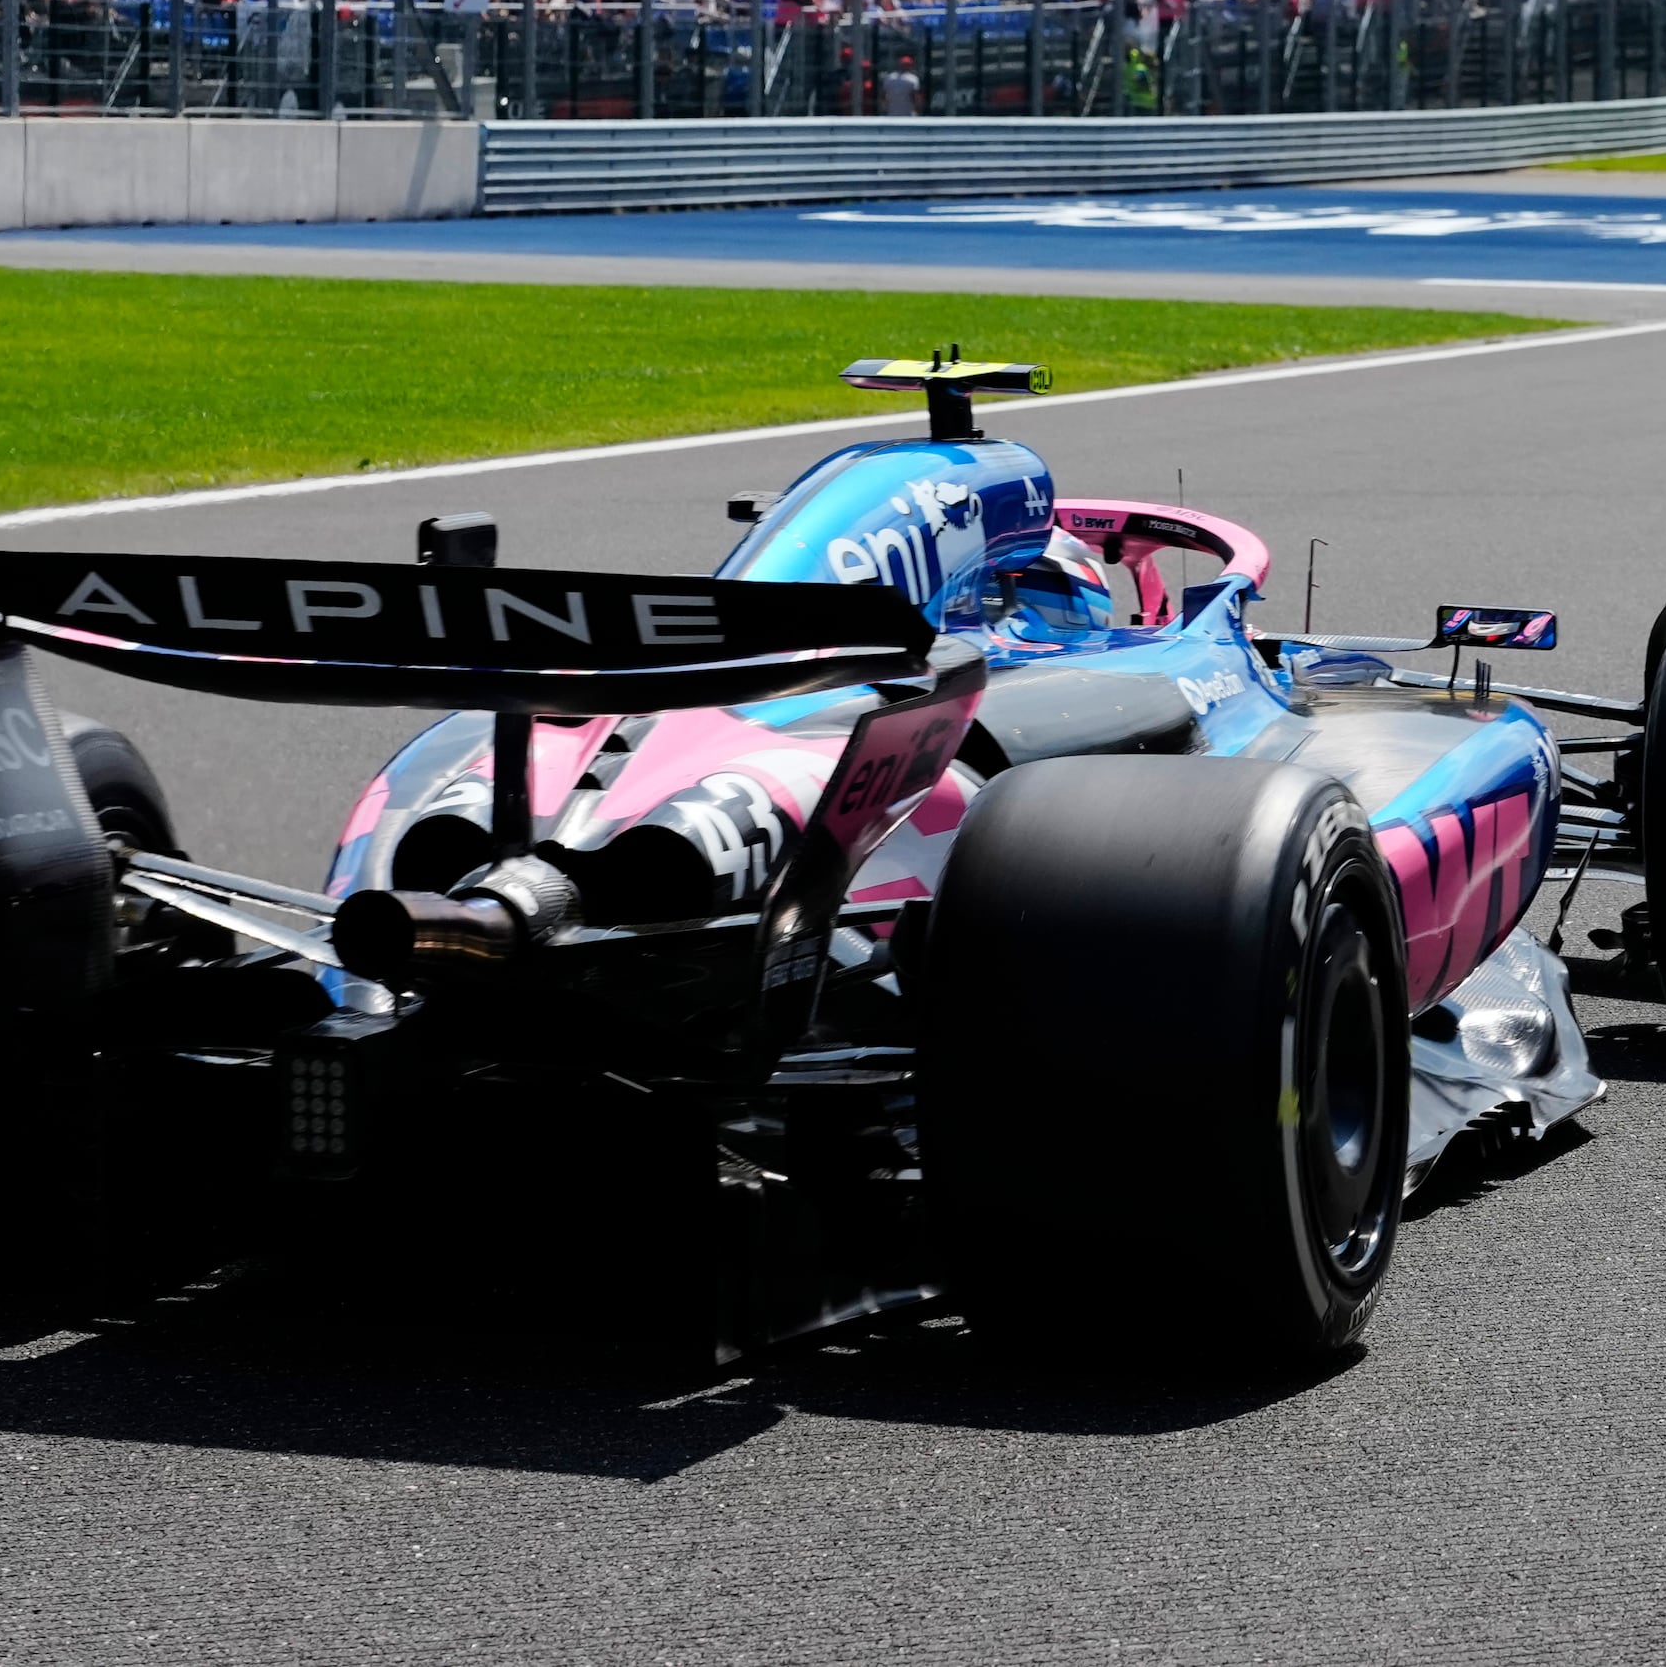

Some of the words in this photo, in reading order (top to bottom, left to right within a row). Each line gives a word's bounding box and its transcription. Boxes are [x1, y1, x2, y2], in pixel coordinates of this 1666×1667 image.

[827, 496, 931, 606] eni
[1084, 517, 1116, 530] BWT
[56, 570, 726, 646] ALPINE
[838, 742, 915, 817] eni
[669, 772, 785, 900] 43
